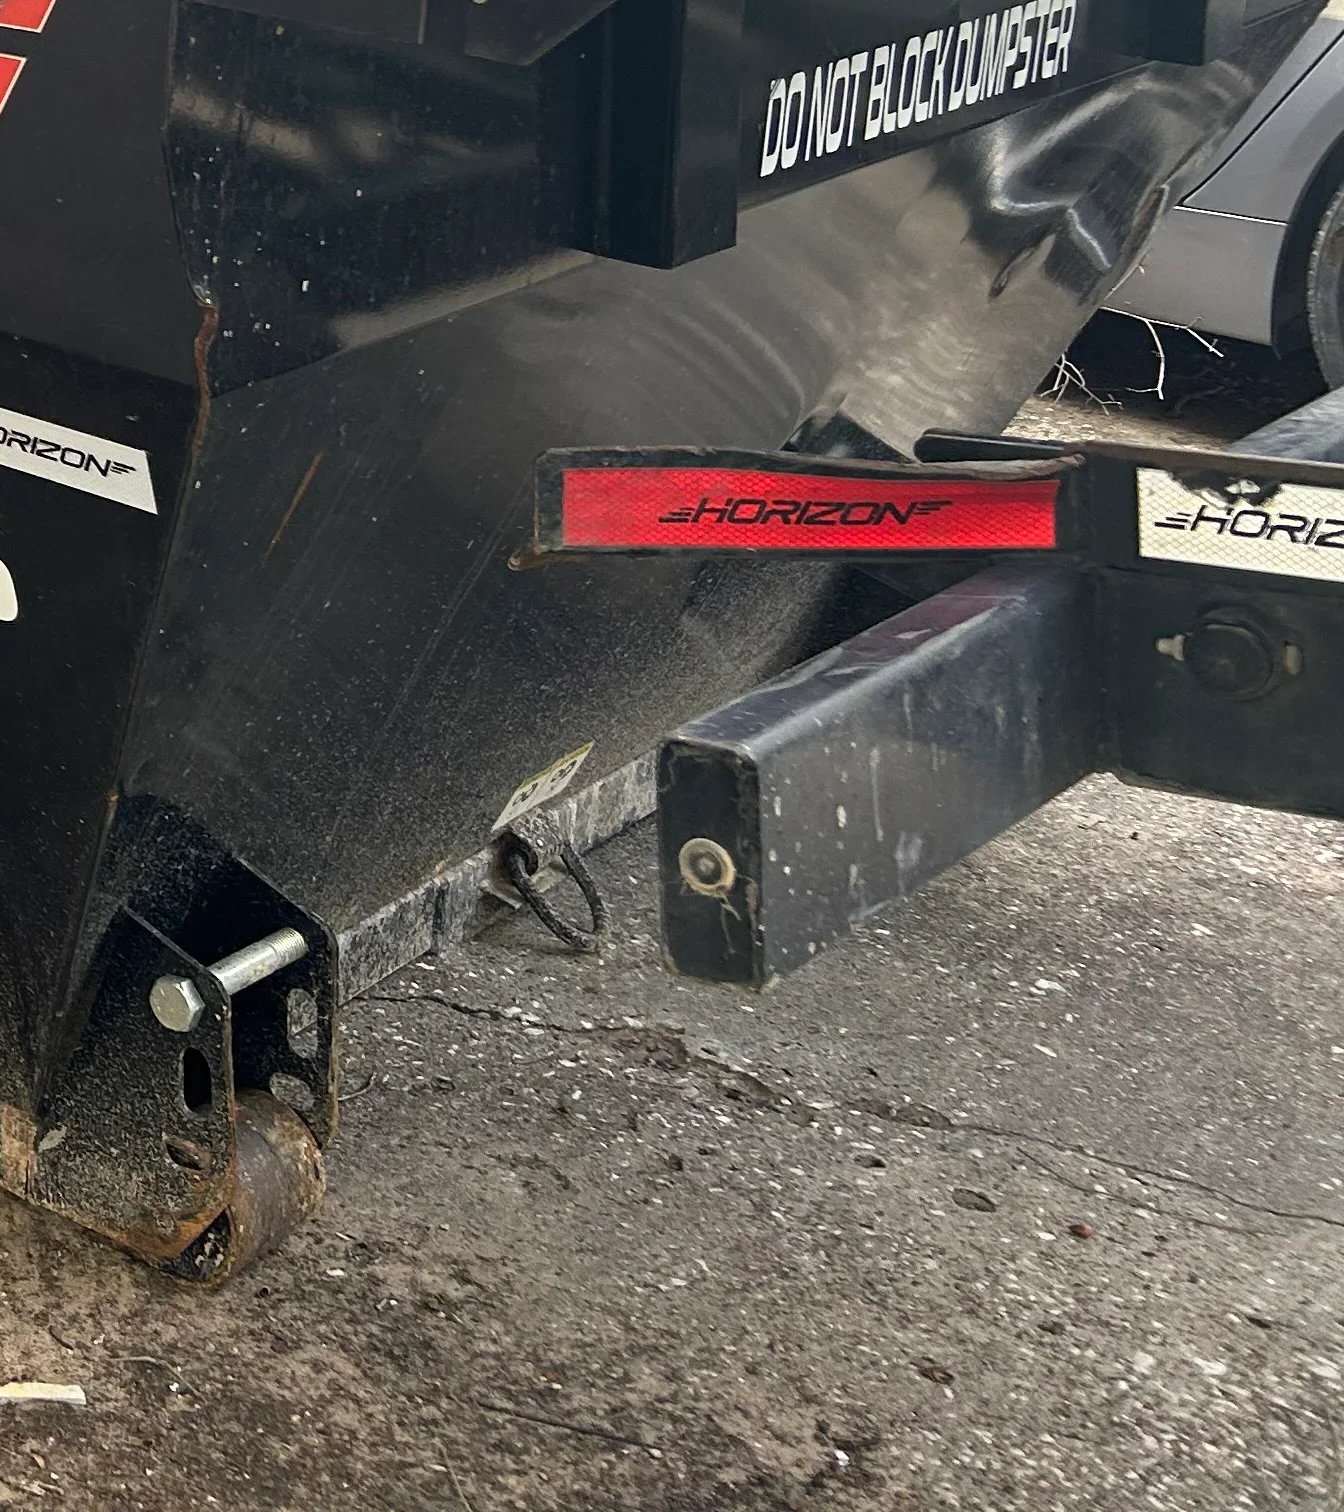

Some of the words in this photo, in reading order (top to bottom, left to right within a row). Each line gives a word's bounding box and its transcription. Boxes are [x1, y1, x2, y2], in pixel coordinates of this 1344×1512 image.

[759, 71, 807, 178] DO
[804, 50, 869, 161] NOT
[864, 25, 955, 141] BLOCK
[688, 496, 917, 527] HORIZON
[1189, 504, 1344, 550] HORIZ
